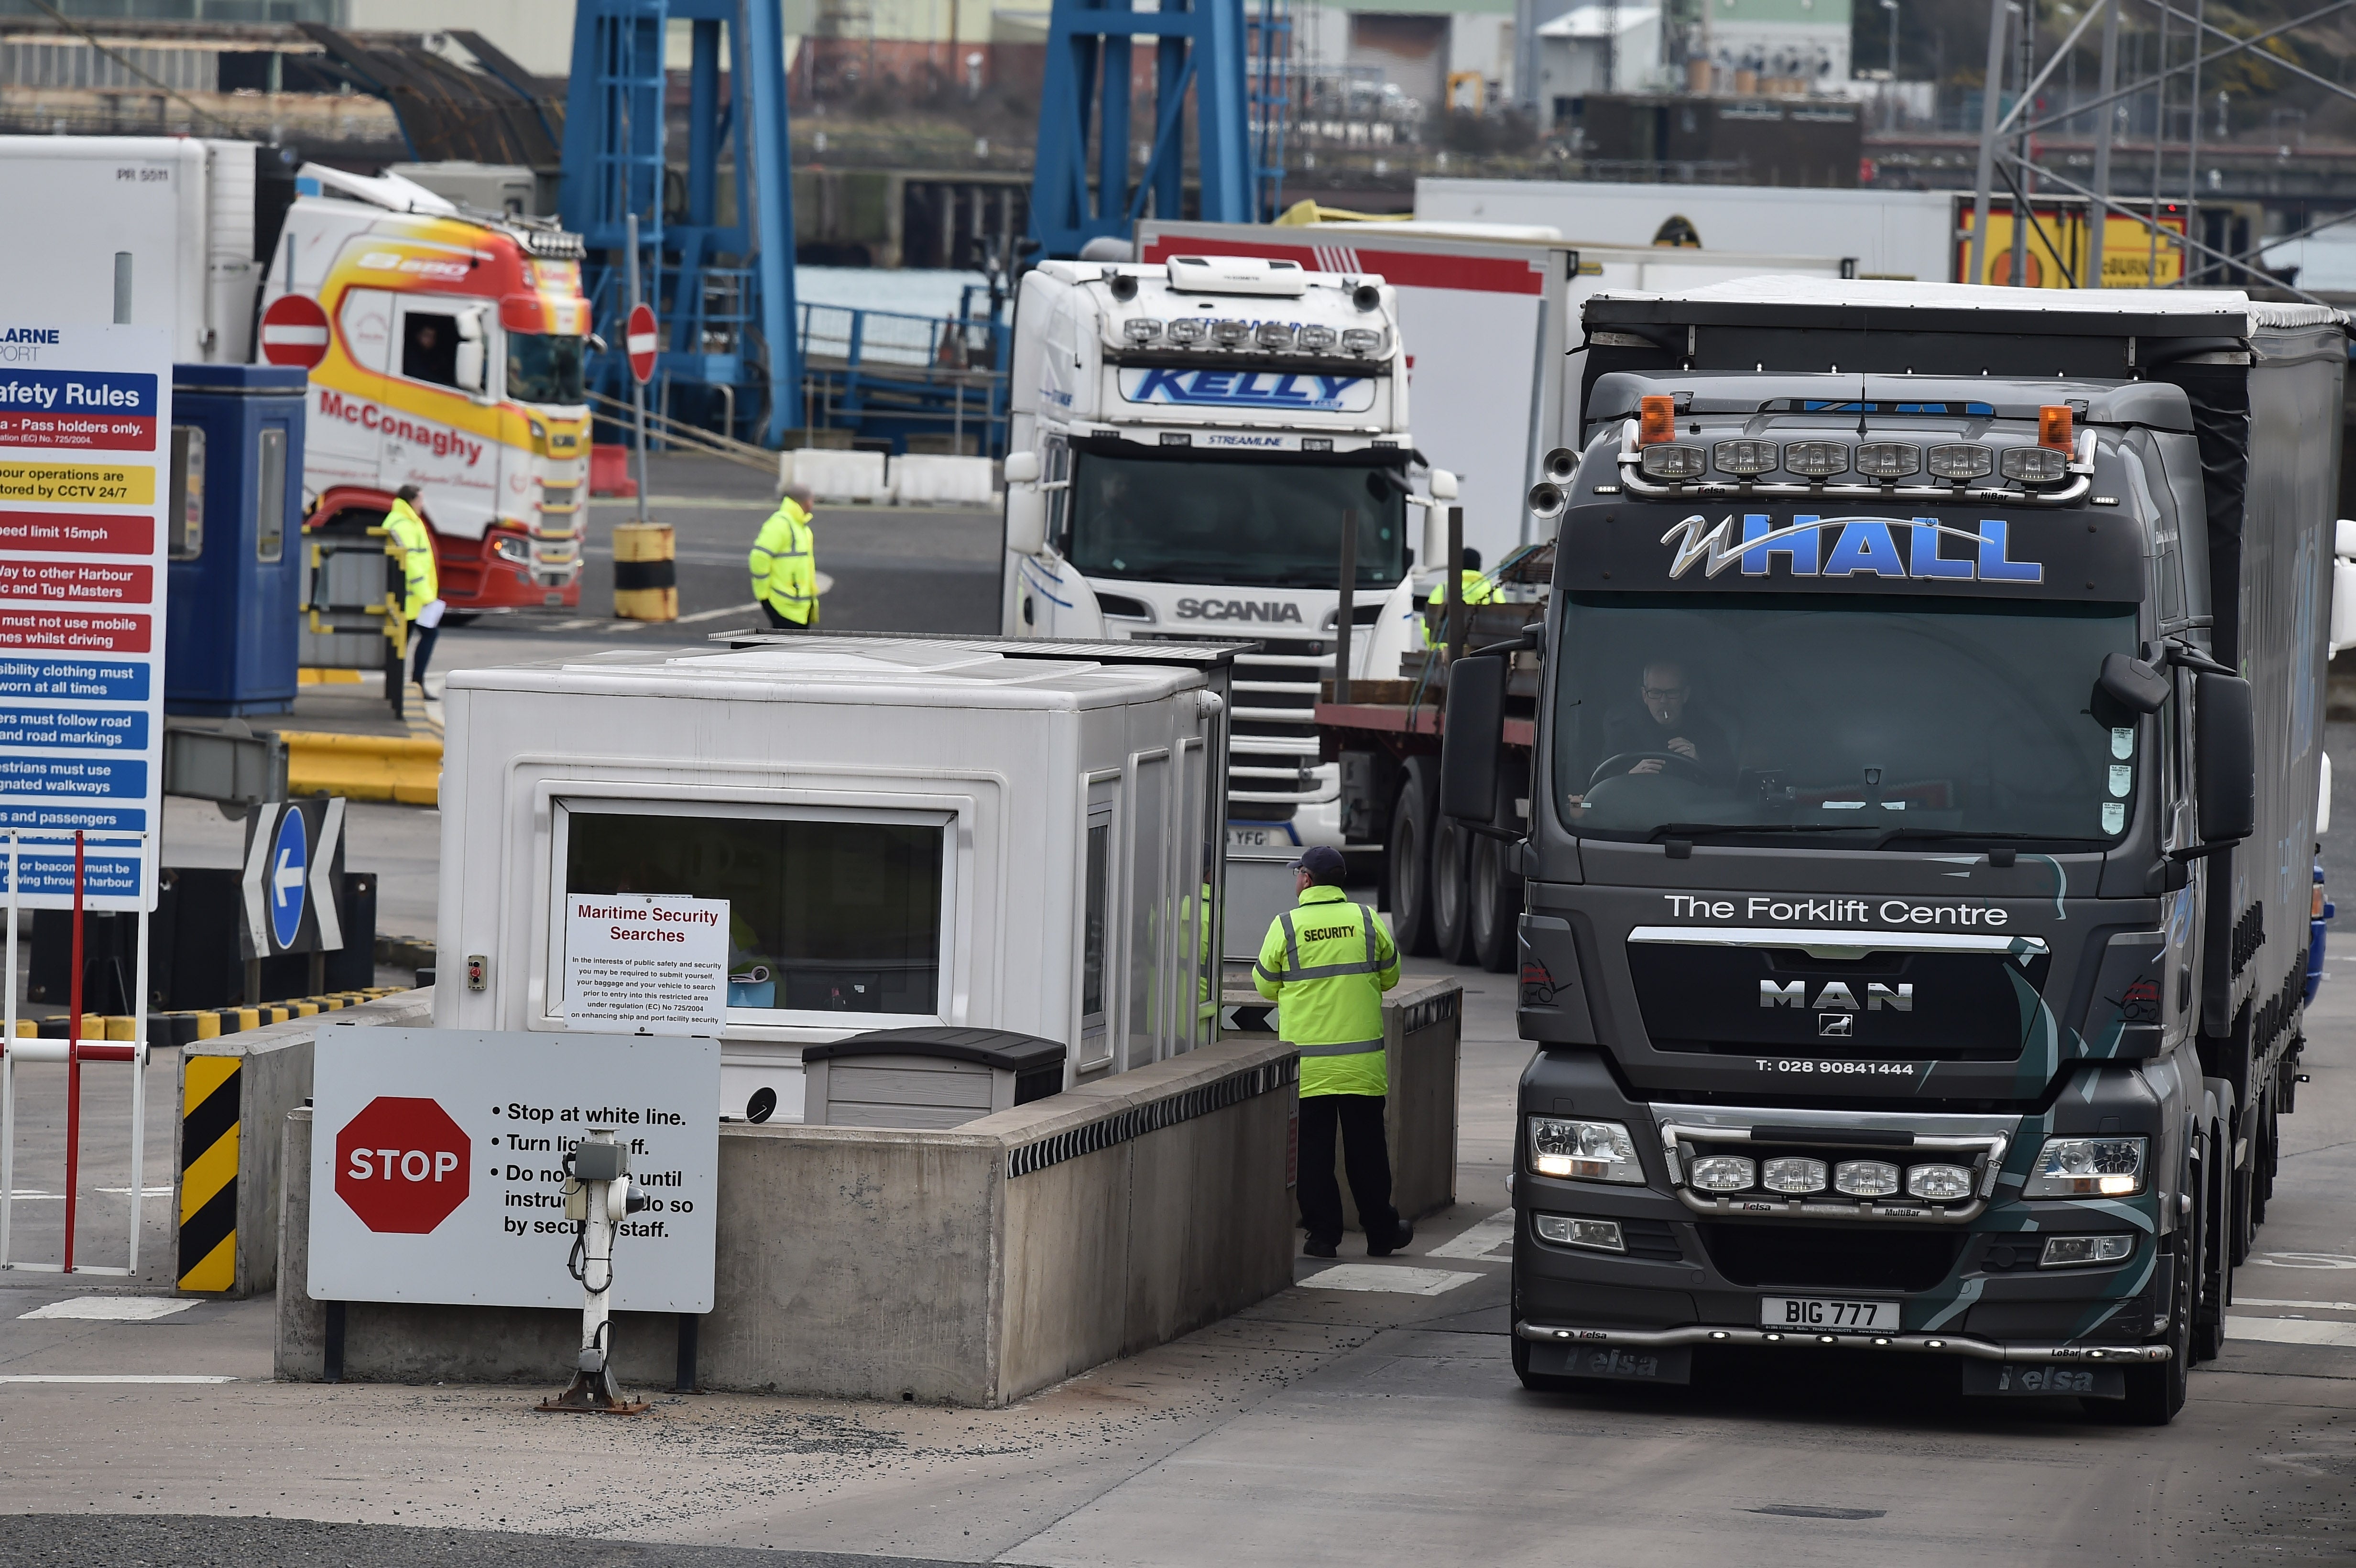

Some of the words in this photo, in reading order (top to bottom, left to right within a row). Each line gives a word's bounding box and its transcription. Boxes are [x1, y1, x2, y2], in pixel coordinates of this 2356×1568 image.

[1131, 368, 1362, 403] KELLY
[67, 383, 140, 407] Rules
[21, 418, 55, 432] Pass
[57, 419, 108, 434] holders
[111, 422, 143, 436] only.
[320, 389, 483, 467] McConaghy
[20, 434, 38, 444] (EC)
[39, 434, 53, 443] No.
[55, 435, 93, 444] 725/2004.
[1209, 435, 1282, 446] STREAMLINE
[0, 469, 25, 478] our
[28, 469, 99, 481] operations
[103, 472, 124, 482] are
[39, 485, 55, 499] by
[58, 485, 96, 497] CCTV
[99, 487, 128, 498] 24/7
[1697, 486, 1725, 495] Kelsa
[1980, 491, 2008, 501] HiBar
[0, 525, 27, 537] eed
[32, 526, 60, 538] limit
[64, 527, 108, 542] 15mph
[23, 567, 36, 578] to
[40, 567, 76, 579] other
[79, 569, 133, 581] Harbour
[13, 583, 37, 594] and
[41, 583, 65, 598] Tug
[69, 584, 122, 598] Masters
[1177, 599, 1303, 624] SCANIA
[2, 616, 35, 627] must
[39, 617, 61, 628] not
[65, 619, 88, 629] use
[92, 618, 136, 631] mobile
[26, 632, 65, 644] whilst
[68, 633, 113, 648] driving
[44, 665, 97, 680] clothing
[101, 669, 134, 679] must
[35, 682, 48, 692] at
[52, 682, 66, 693] all
[70, 682, 107, 695] times
[21, 714, 54, 725] must
[57, 714, 98, 726] follow
[101, 716, 131, 727] road
[27, 730, 56, 741] road
[61, 731, 122, 746] markings
[51, 764, 84, 775] must
[87, 767, 111, 775] use
[46, 780, 110, 795] walkways
[12, 811, 36, 822] and
[41, 815, 117, 827] passengers
[85, 864, 113, 874] must
[115, 864, 130, 874] be
[89, 877, 134, 888] harbour
[578, 905, 648, 921] Maritime
[653, 908, 719, 927] Security
[1665, 895, 1735, 919] The
[1748, 898, 1869, 923] Forklift
[1880, 901, 2008, 926] Centre
[611, 926, 685, 943] Searches
[1304, 926, 1355, 942] SECURITY
[633, 959, 655, 967] public
[657, 960, 677, 969] safety
[694, 962, 721, 970] security
[620, 969, 649, 978] required
[594, 979, 624, 988] baggage
[583, 990, 600, 998] prior
[1760, 980, 1914, 1012] MAN
[645, 1003, 661, 1012] (EC)
[581, 1012, 618, 1021] enhancing
[619, 1013, 634, 1021] ship
[666, 1015, 689, 1024] facility
[691, 1016, 719, 1025] security
[1756, 1060, 1772, 1071] T:
[1779, 1061, 1814, 1073] 028
[1820, 1062, 1914, 1076] 90841444
[508, 1103, 555, 1125] Stop
[561, 1107, 580, 1122] at
[586, 1107, 640, 1124] white
[647, 1109, 686, 1126] line.
[507, 1134, 550, 1151] Turn
[631, 1139, 649, 1155] ff.
[348, 1148, 458, 1183] STOP
[506, 1165, 534, 1182] Do
[540, 1170, 565, 1183] no
[640, 1171, 682, 1187] until
[670, 1200, 694, 1213] so
[1743, 1202, 1771, 1211] Kelsa
[1885, 1209, 1920, 1218] MultiBar
[504, 1216, 528, 1236] by
[620, 1220, 669, 1238] staff.
[1786, 1301, 1823, 1324] BIG
[1831, 1303, 1878, 1326] 777
[1579, 1330, 1607, 1339] Kelsa
[2051, 1349, 2081, 1358] LoBar
